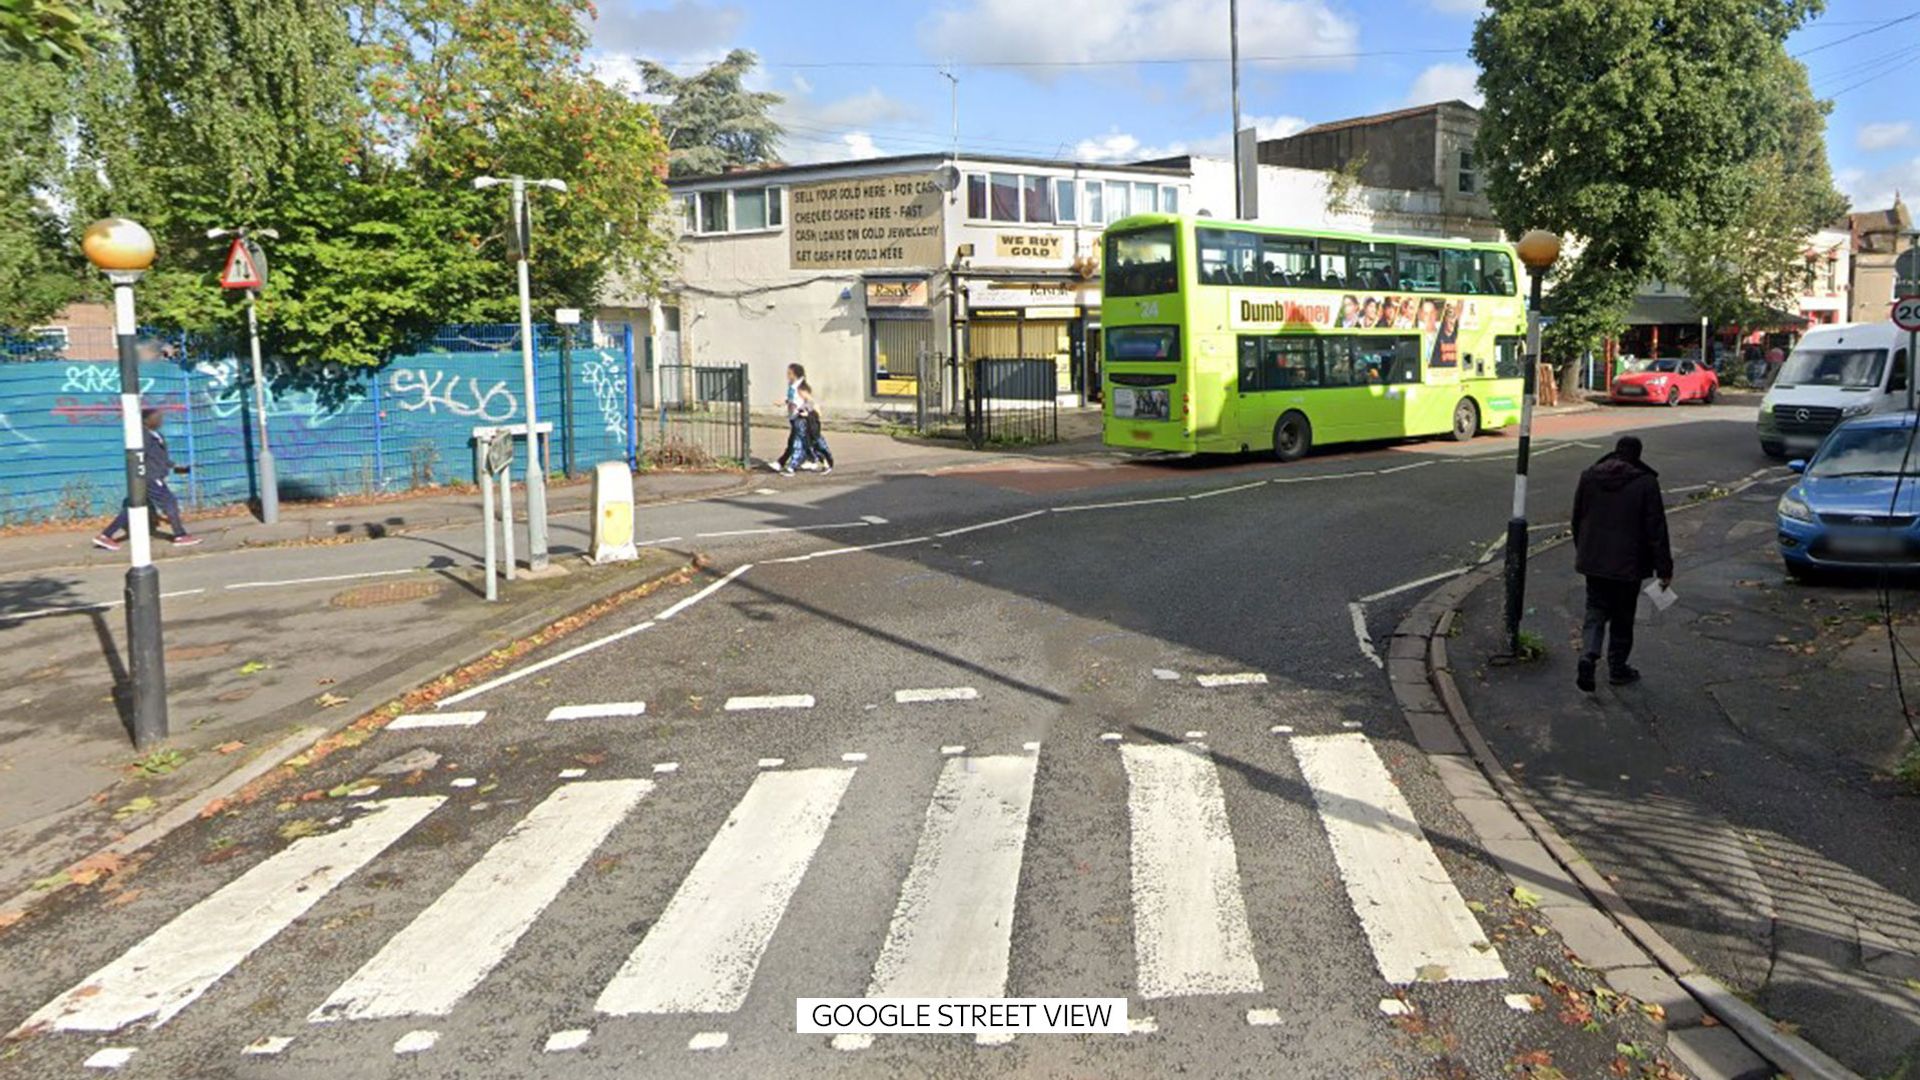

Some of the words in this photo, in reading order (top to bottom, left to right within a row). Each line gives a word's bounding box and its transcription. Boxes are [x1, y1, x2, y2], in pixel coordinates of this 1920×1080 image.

[794, 191, 814, 203] SELL
[816, 188, 838, 201] YOUR
[839, 186, 861, 200] GOLD
[863, 184, 886, 198] HERE
[894, 182, 912, 196] FOR
[794, 209, 832, 224] CHEQUES
[833, 207, 866, 221] CASHED
[868, 206, 891, 219] HERE
[900, 204, 923, 218] FAST
[795, 229, 818, 241] CASH
[819, 228, 845, 242] LOANS
[847, 228, 860, 240] ON
[861, 226, 885, 240] GOLD
[887, 224, 940, 238] JEWELLERY
[1001, 235, 1024, 246] WE
[1029, 236, 1059, 247] BUY
[796, 249, 812, 262] GET
[814, 249, 834, 262] CASH
[836, 248, 853, 261] FOR
[854, 247, 878, 261] GOLD
[879, 247, 904, 260] HERE
[1011, 246, 1050, 257] GOLD
